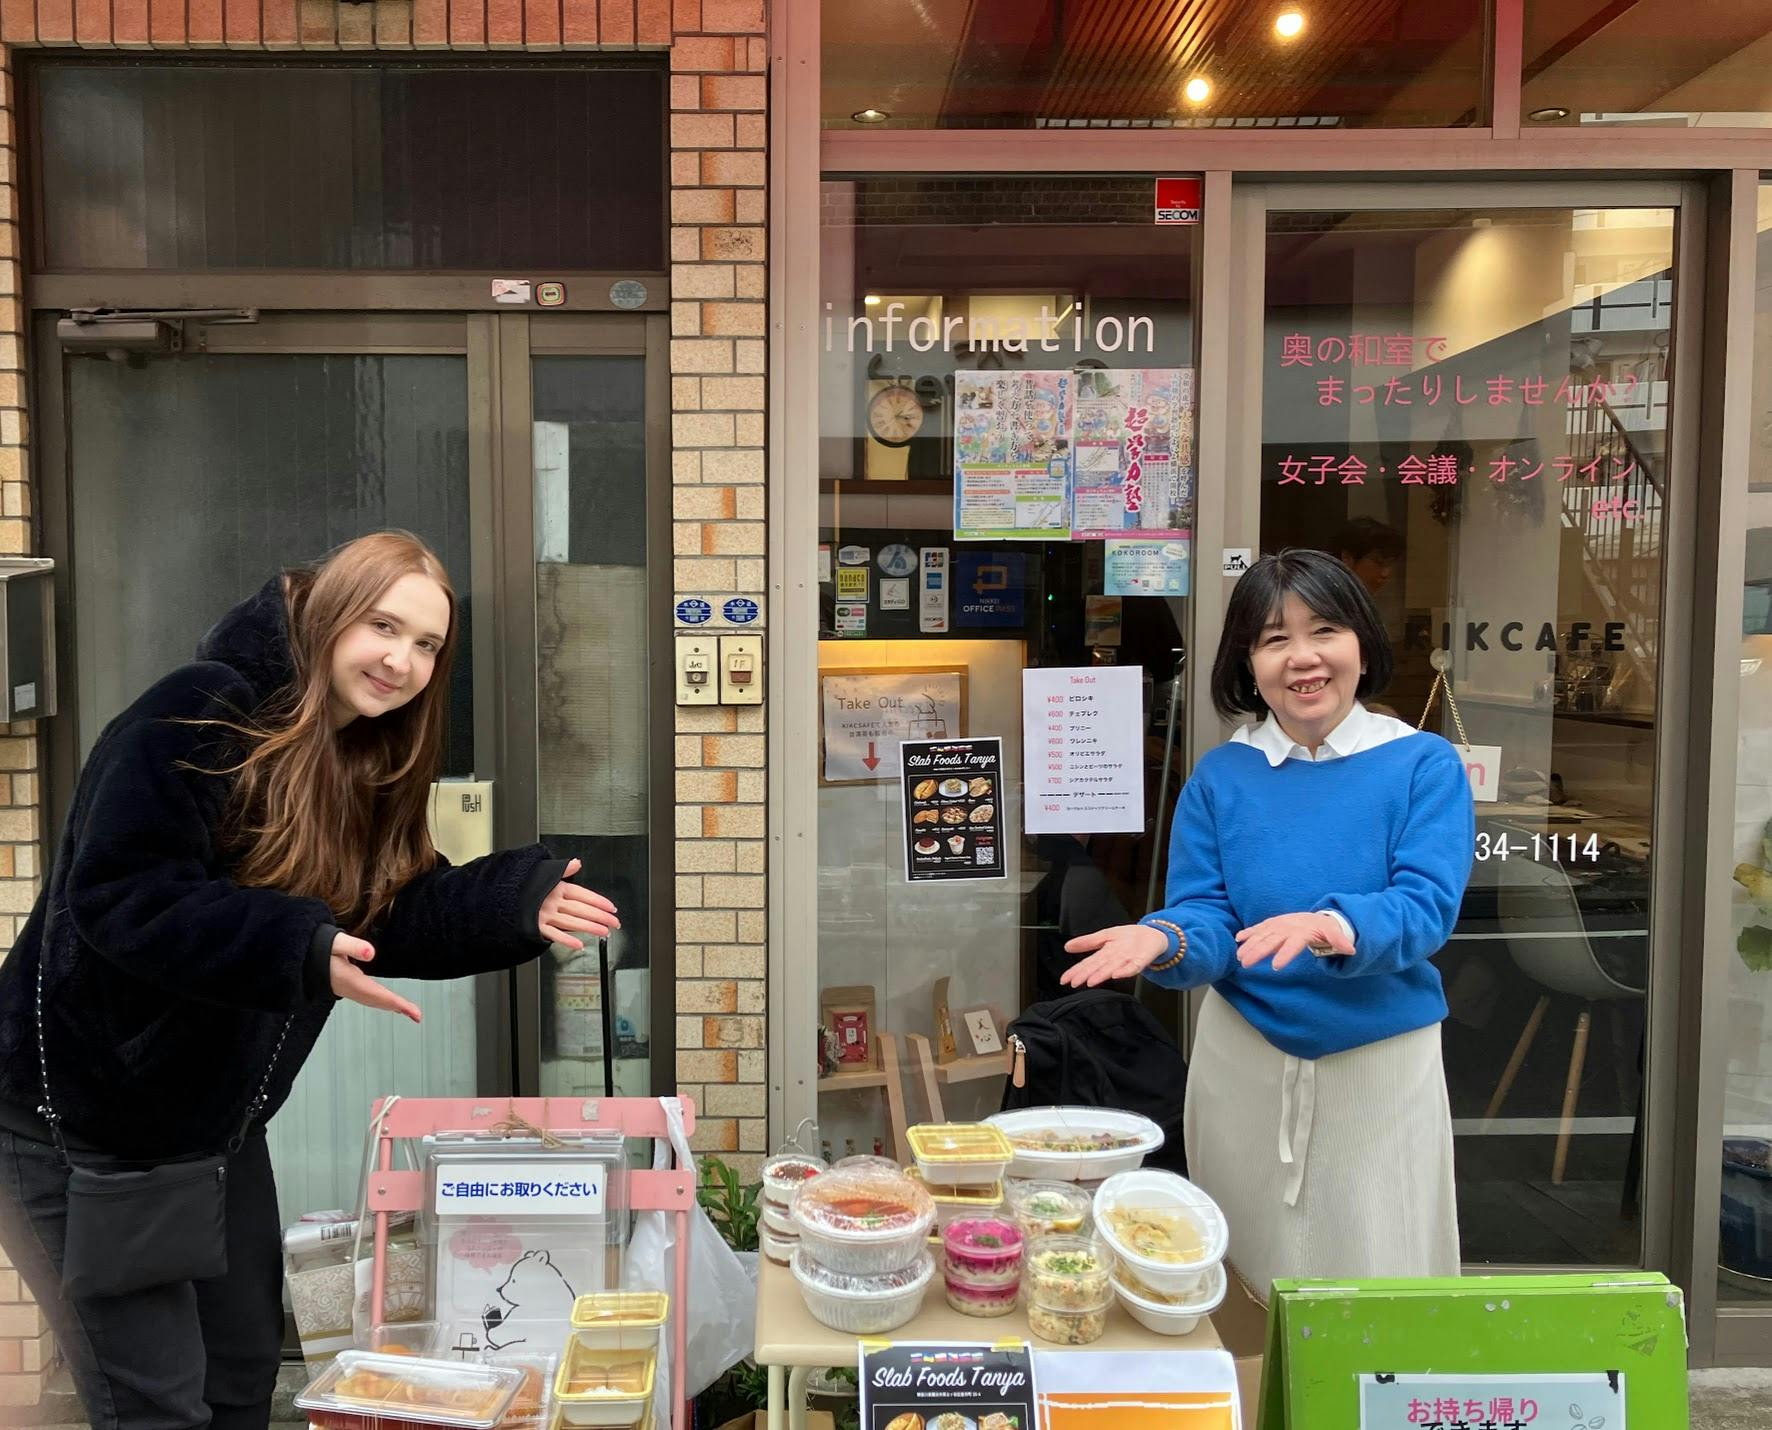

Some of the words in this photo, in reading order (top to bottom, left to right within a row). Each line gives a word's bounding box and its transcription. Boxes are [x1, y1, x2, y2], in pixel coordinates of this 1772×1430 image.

[1158, 210, 1198, 220] SECOM
[825, 302, 1155, 353] information
[1280, 333, 1448, 367] 奥の和室で
[1124, 407, 1148, 511] 超学力塾
[1278, 454, 1637, 486] 女子会・会議・オンライン
[1592, 496, 1646, 520] etc.
[963, 605, 994, 613] OFFICE
[1070, 676, 1083, 684] Take
[1085, 676, 1096, 684] Out
[837, 697, 871, 710] Take
[878, 696, 905, 709] Out
[907, 754, 931, 767] Slab
[933, 753, 962, 766] Foods
[964, 752, 997, 768] Tanya
[442, 1182, 597, 1198] ご自由にお取りください
[872, 1366, 913, 1388] Slab
[916, 1366, 967, 1388] Foods
[971, 1366, 1026, 1396] Tanya
[1407, 1397, 1539, 1424] お持ち帰り
